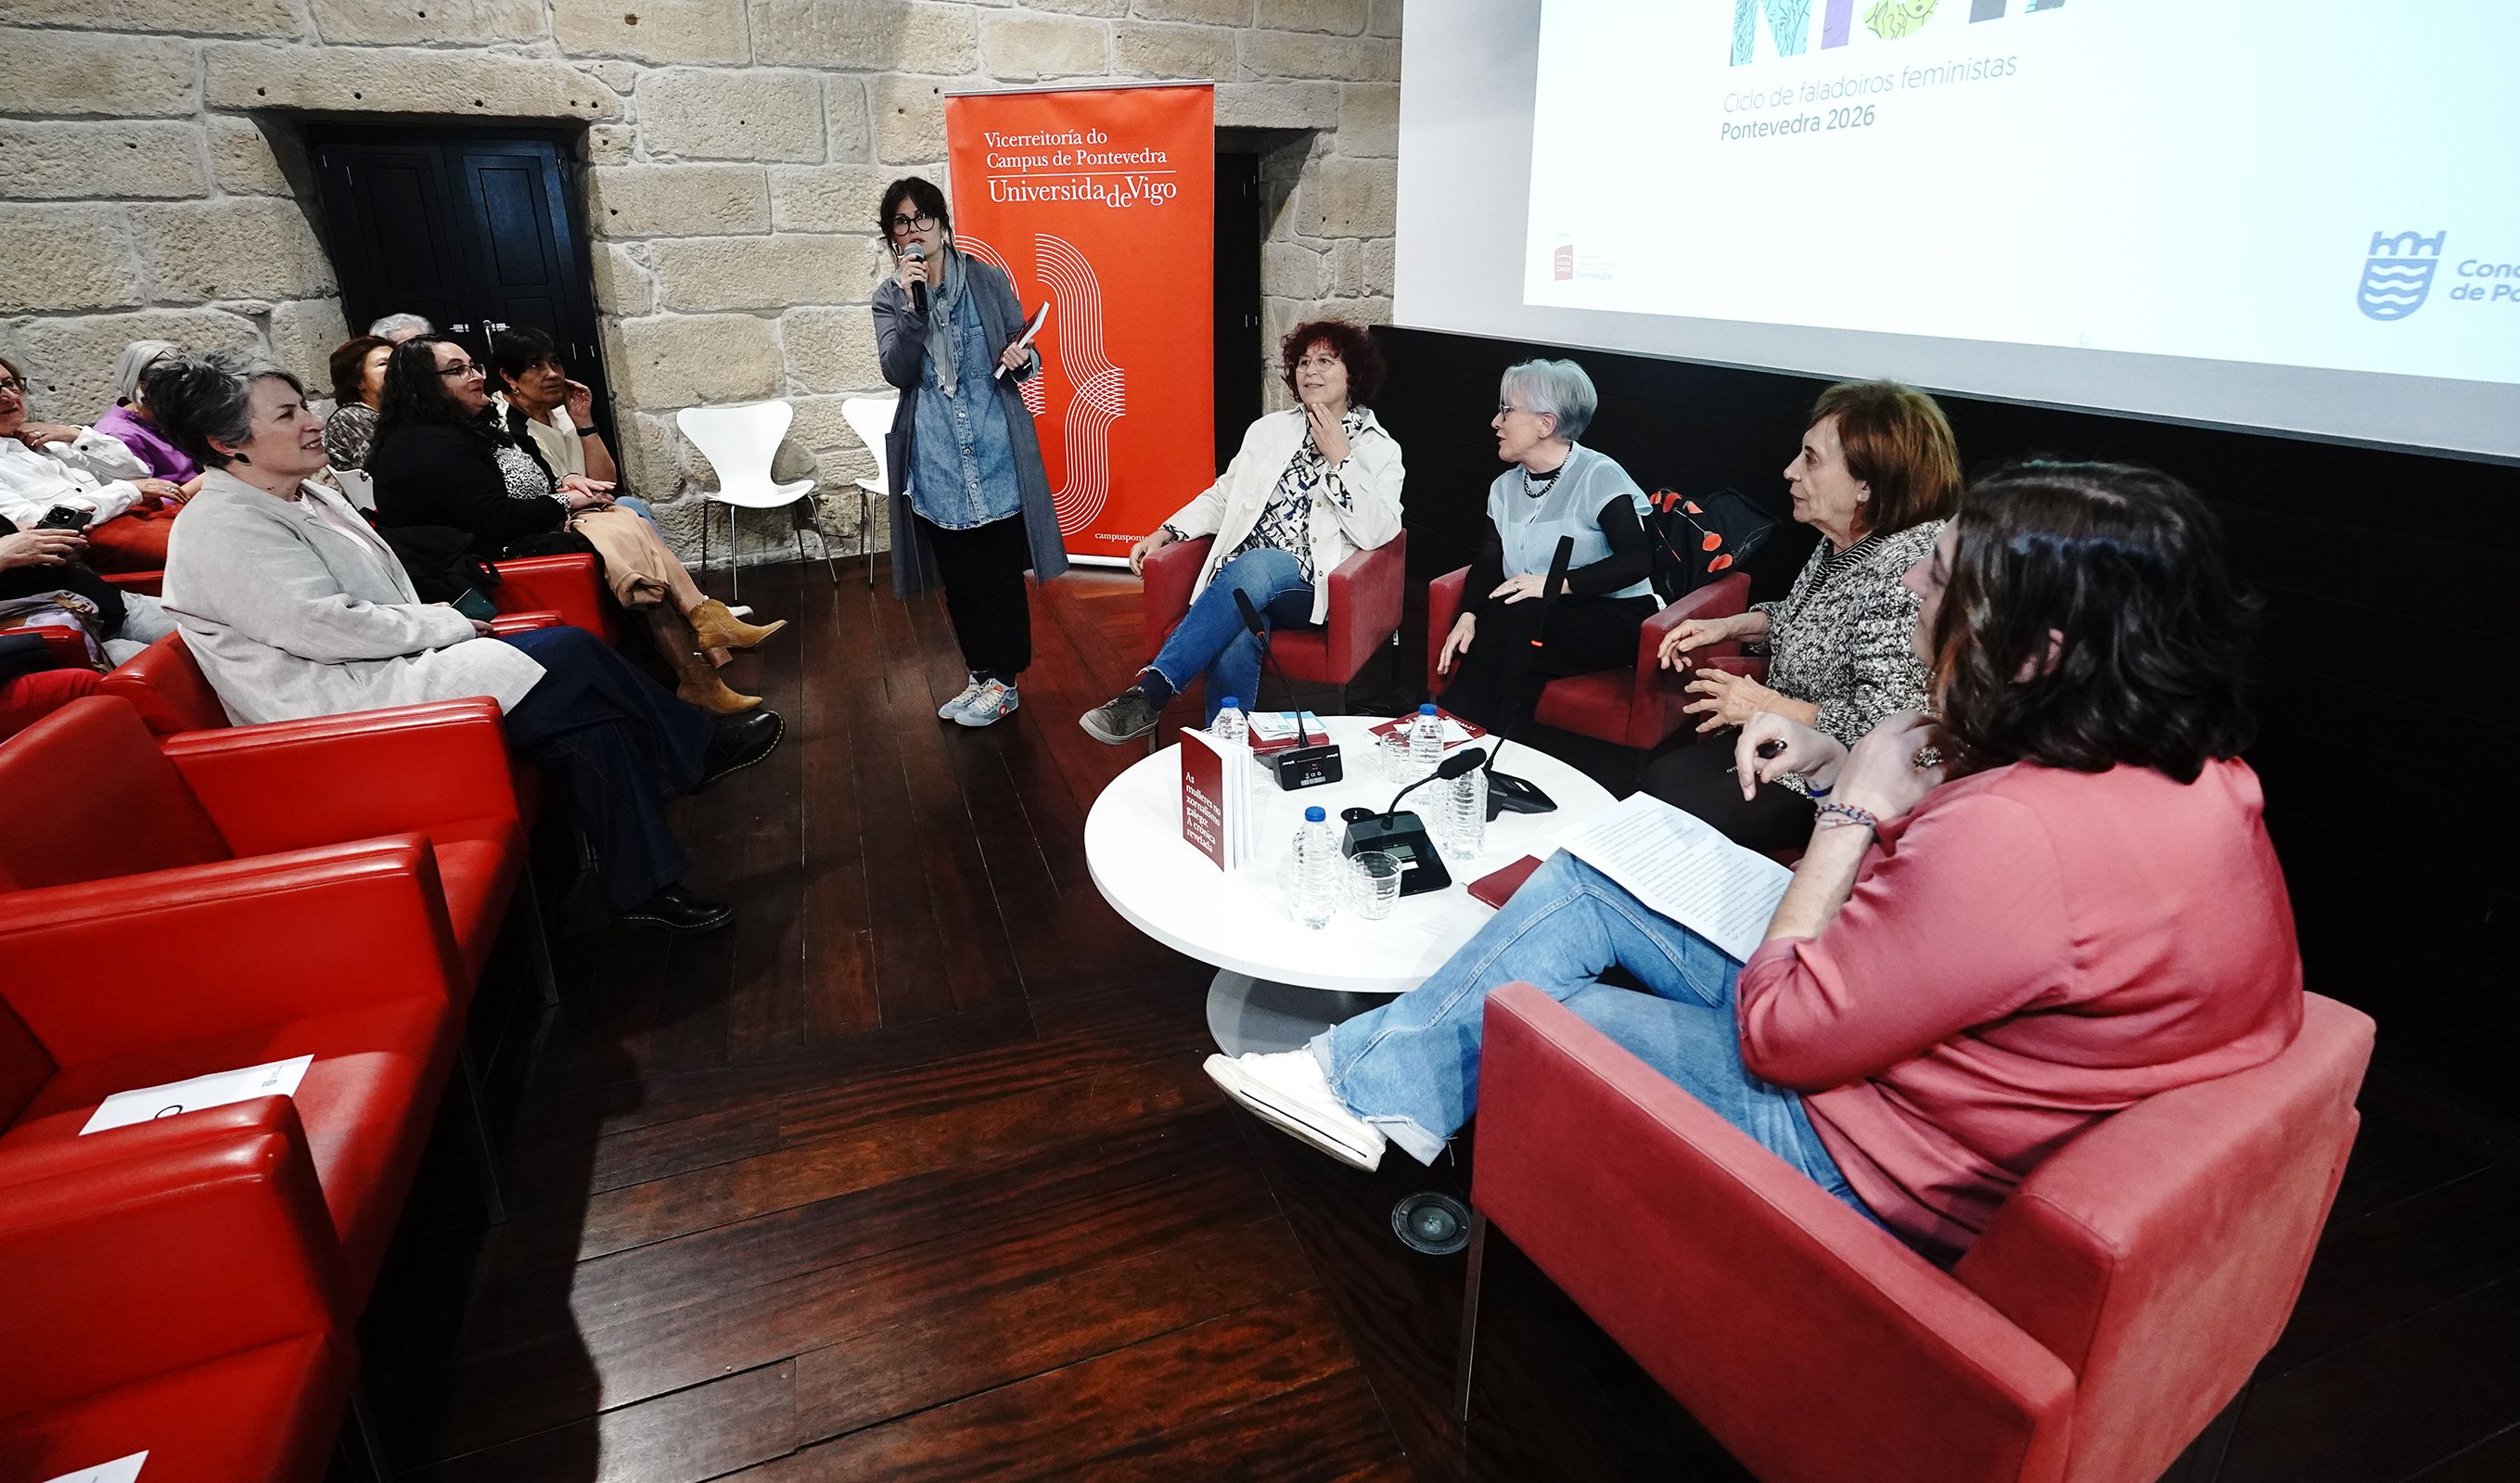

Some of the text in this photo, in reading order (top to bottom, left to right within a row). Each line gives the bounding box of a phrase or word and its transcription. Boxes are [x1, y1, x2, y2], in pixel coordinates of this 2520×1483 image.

[1722, 54, 2018, 113] Ciclo de faladoiros feministas
[1721, 105, 1875, 142] Pontevedra 2026
[984, 128, 1107, 148] Vicerreitoría do
[986, 147, 1167, 173] Campus de Pontevedra
[2450, 282, 2486, 301] de
[1186, 773, 1195, 784] As
[1186, 785, 1221, 816] mulleres no
[1186, 795, 1221, 826] xornalismo
[1187, 817, 1193, 826] A
[1186, 828, 1213, 853] revelada
